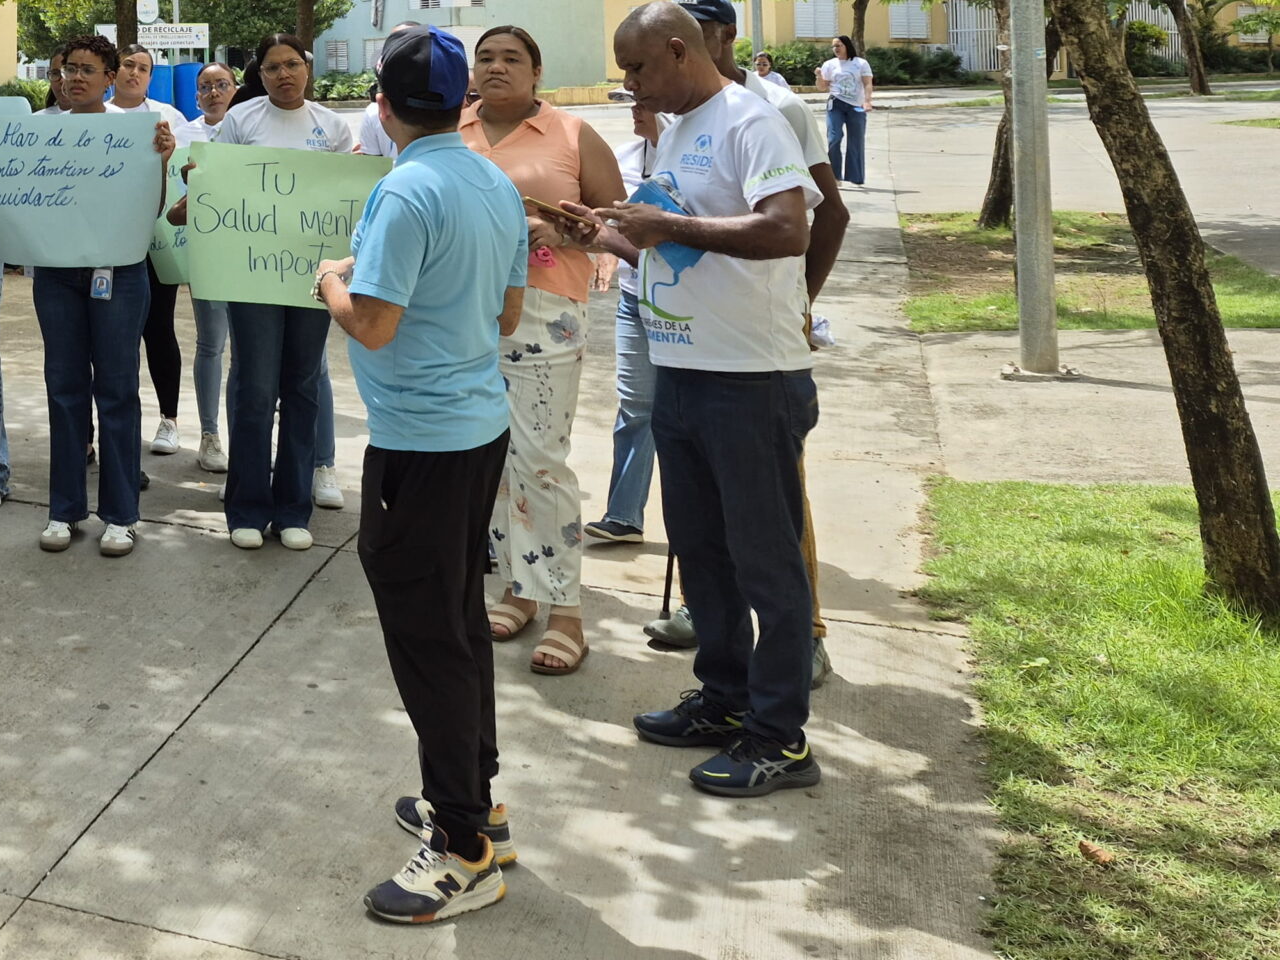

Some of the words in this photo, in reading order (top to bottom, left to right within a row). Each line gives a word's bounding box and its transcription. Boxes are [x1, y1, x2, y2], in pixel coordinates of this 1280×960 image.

[44, 128, 64, 148] de
[72, 129, 95, 148] lo
[104, 133, 134, 154] que
[99, 161, 125, 178] es
[194, 192, 277, 234] Salud
[664, 321, 678, 331] DE
[679, 322, 692, 332] LA
